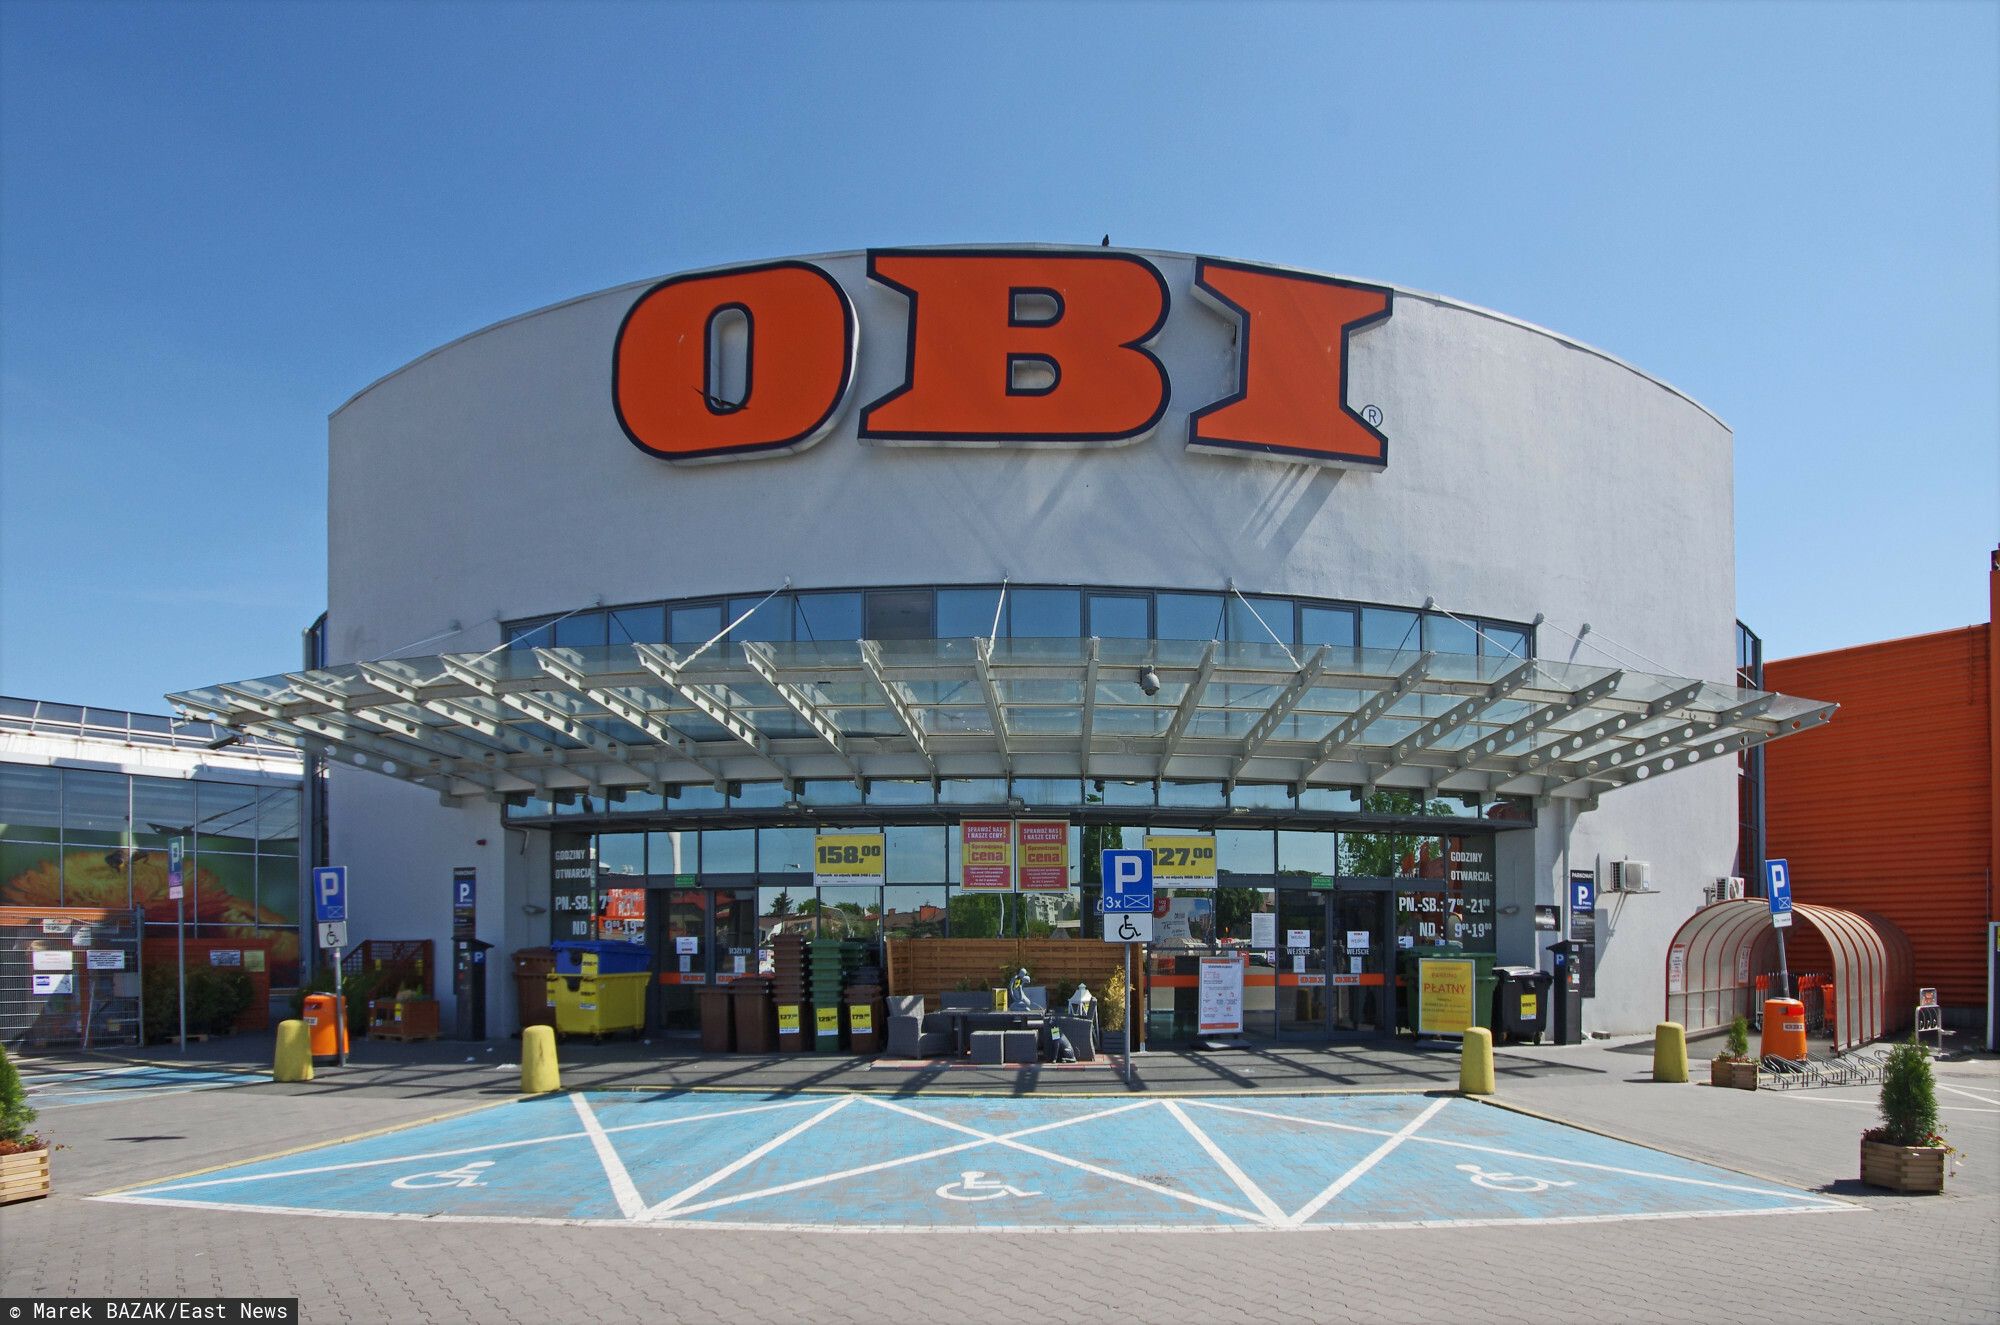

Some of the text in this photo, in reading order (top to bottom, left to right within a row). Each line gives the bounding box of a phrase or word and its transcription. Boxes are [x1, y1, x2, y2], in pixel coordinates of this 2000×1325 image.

[611, 247, 1393, 468] OBI
[555, 850, 585, 860] GODZINY
[971, 851, 1004, 861] cena
[1027, 853, 1060, 863] cena
[1450, 851, 1483, 863] GODZINY
[1114, 855, 1143, 894] P
[1450, 870, 1493, 882] OTWARCIA:
[1771, 864, 1786, 898] P
[321, 871, 340, 906] P
[460, 883, 470, 902] P
[1577, 885, 1589, 905] P
[1105, 896, 1122, 909] 3x
[572, 920, 587, 935] ND
[1556, 954, 1565, 965] P
[1423, 982, 1467, 994] PŁATNY
